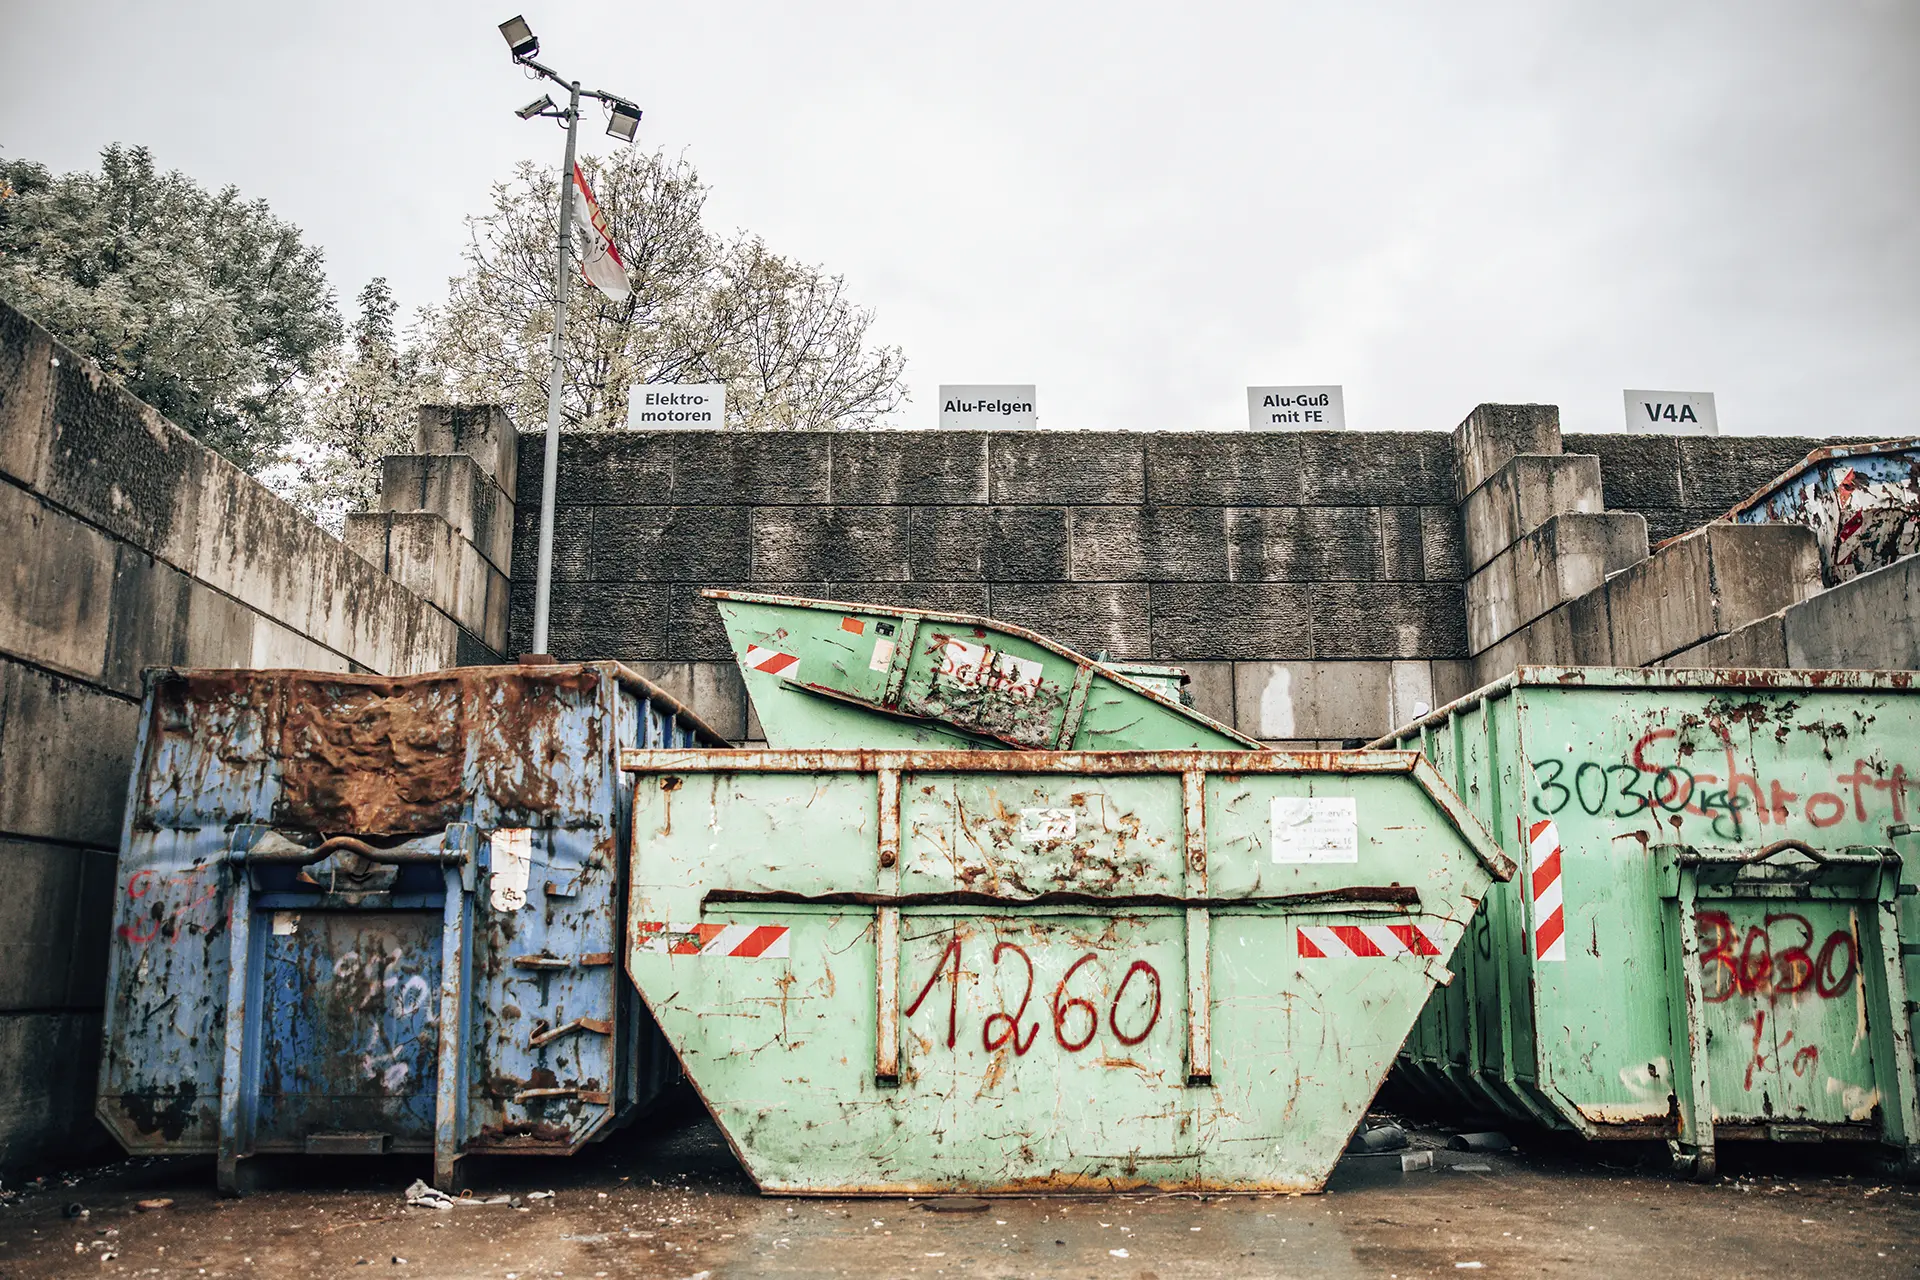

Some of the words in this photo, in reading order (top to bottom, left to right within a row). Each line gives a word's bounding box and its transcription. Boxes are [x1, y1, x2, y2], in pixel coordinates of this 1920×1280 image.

[645, 392, 709, 406] Elektro-
[943, 399, 1032, 416] Alu-Felgen
[1262, 393, 1329, 407] Alu-Guß
[641, 409, 712, 422] motoren
[1271, 410, 1300, 423] mit
[1304, 410, 1323, 422] FE
[1644, 402, 1698, 423] V4A
[1632, 727, 1920, 828] Schrott
[1532, 758, 1695, 818] 3030
[904, 935, 1162, 1057] 1260
